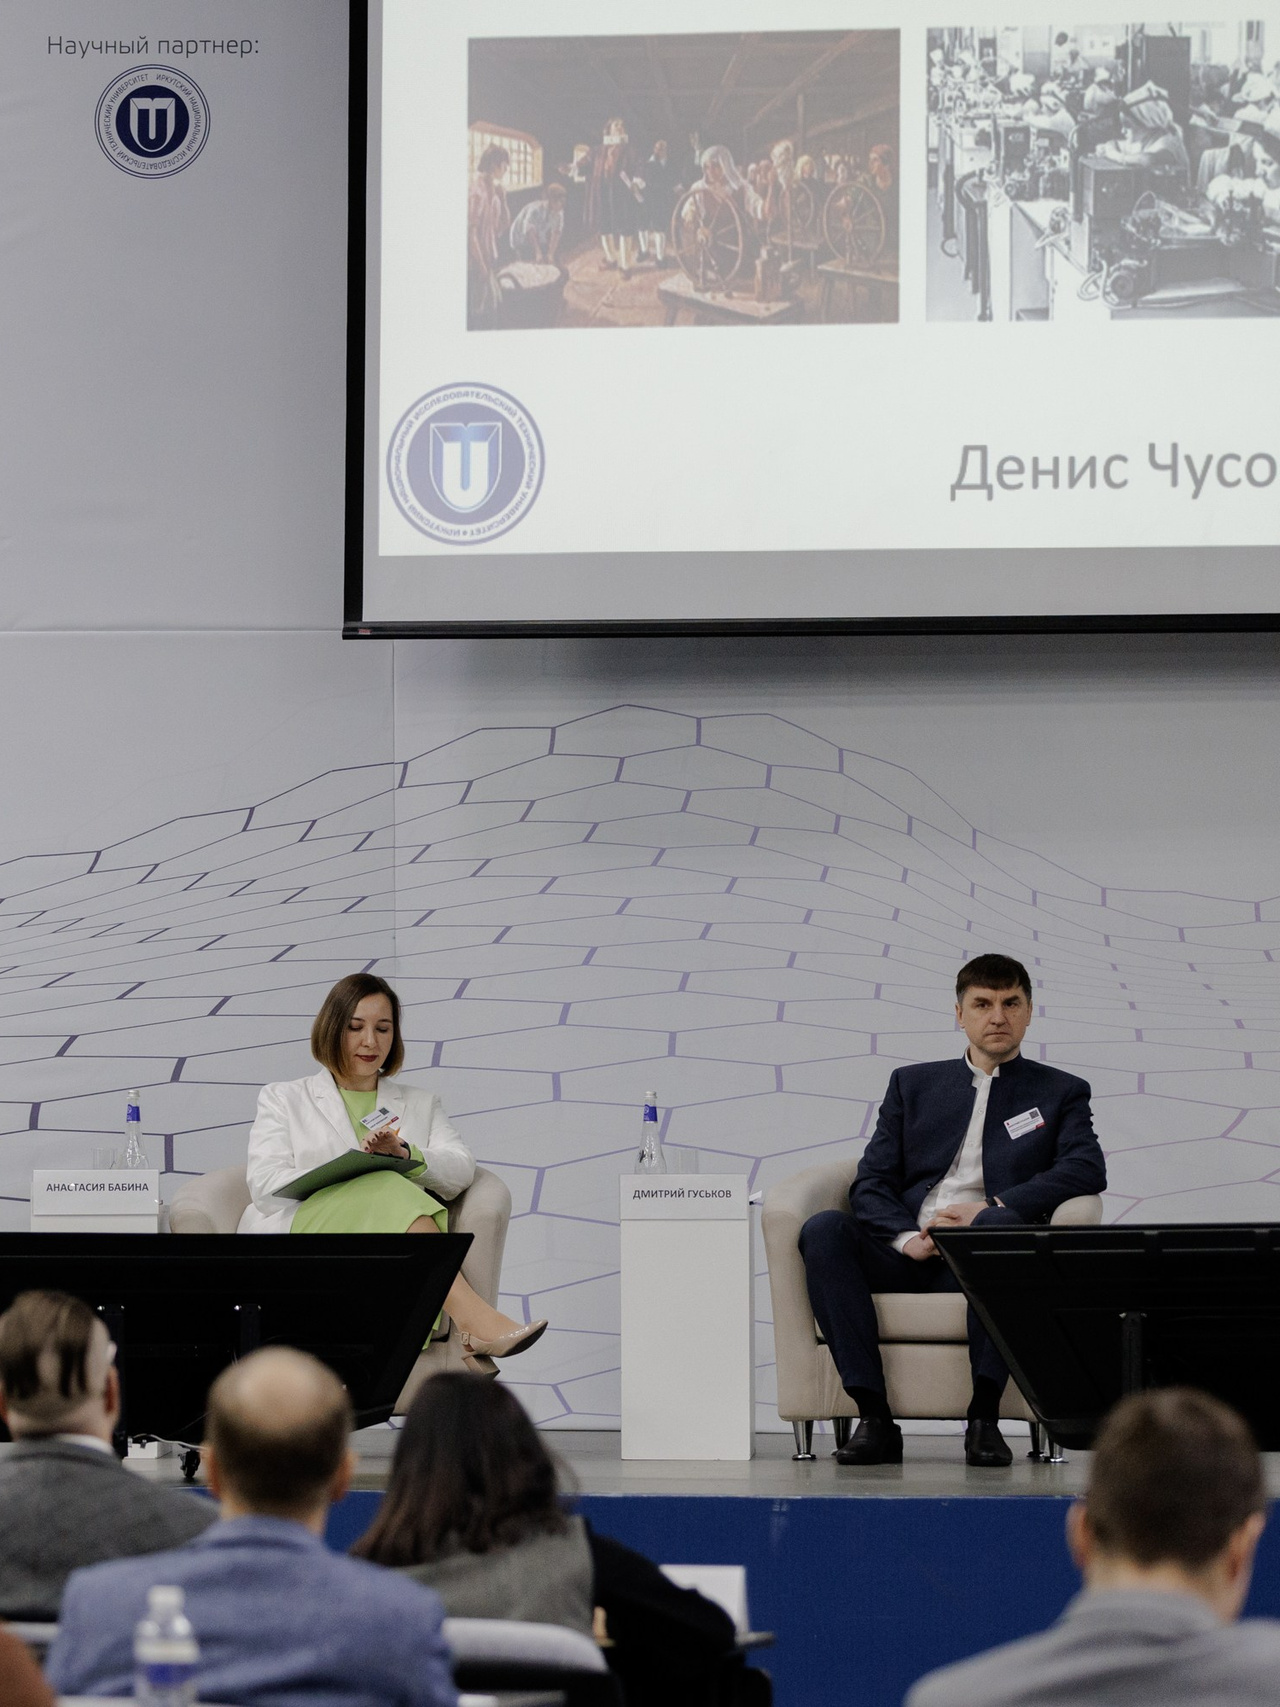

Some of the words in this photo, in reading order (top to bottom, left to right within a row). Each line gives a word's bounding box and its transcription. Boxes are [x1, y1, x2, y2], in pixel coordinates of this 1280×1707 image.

[47, 35, 149, 58] Научный
[157, 37, 259, 60] партнер:
[108, 73, 149, 104] УНИВЕРСИТЕТ
[156, 73, 194, 98] ИРКУТСКИЙ
[950, 444, 1129, 502] Денис
[108, 1183, 150, 1192] БАБИНА
[632, 1187, 686, 1200] ДМИТРИЙ
[687, 1189, 733, 1199] ГУСЬКОВ
